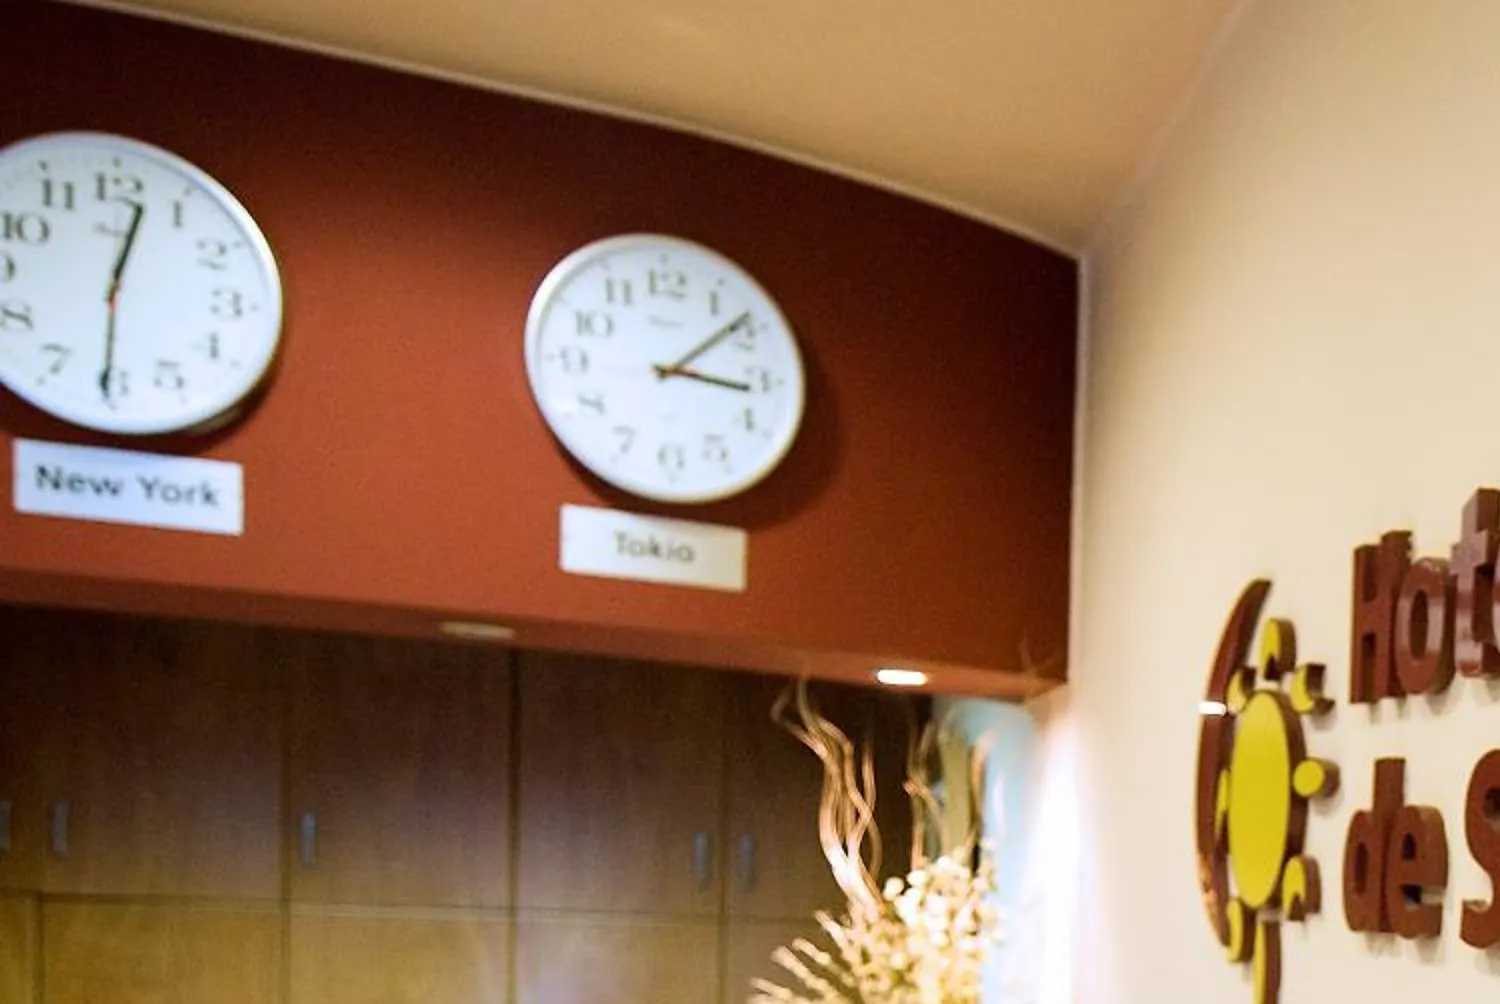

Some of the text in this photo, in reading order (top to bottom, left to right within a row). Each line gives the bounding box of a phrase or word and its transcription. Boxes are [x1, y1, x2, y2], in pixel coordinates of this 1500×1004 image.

[40, 177, 76, 210] 11
[2, 210, 50, 246] 10
[604, 276, 634, 306] 11
[647, 268, 688, 302] 12
[574, 310, 615, 340] 10
[34, 464, 220, 507] New York
[1342, 757, 1448, 940] de
